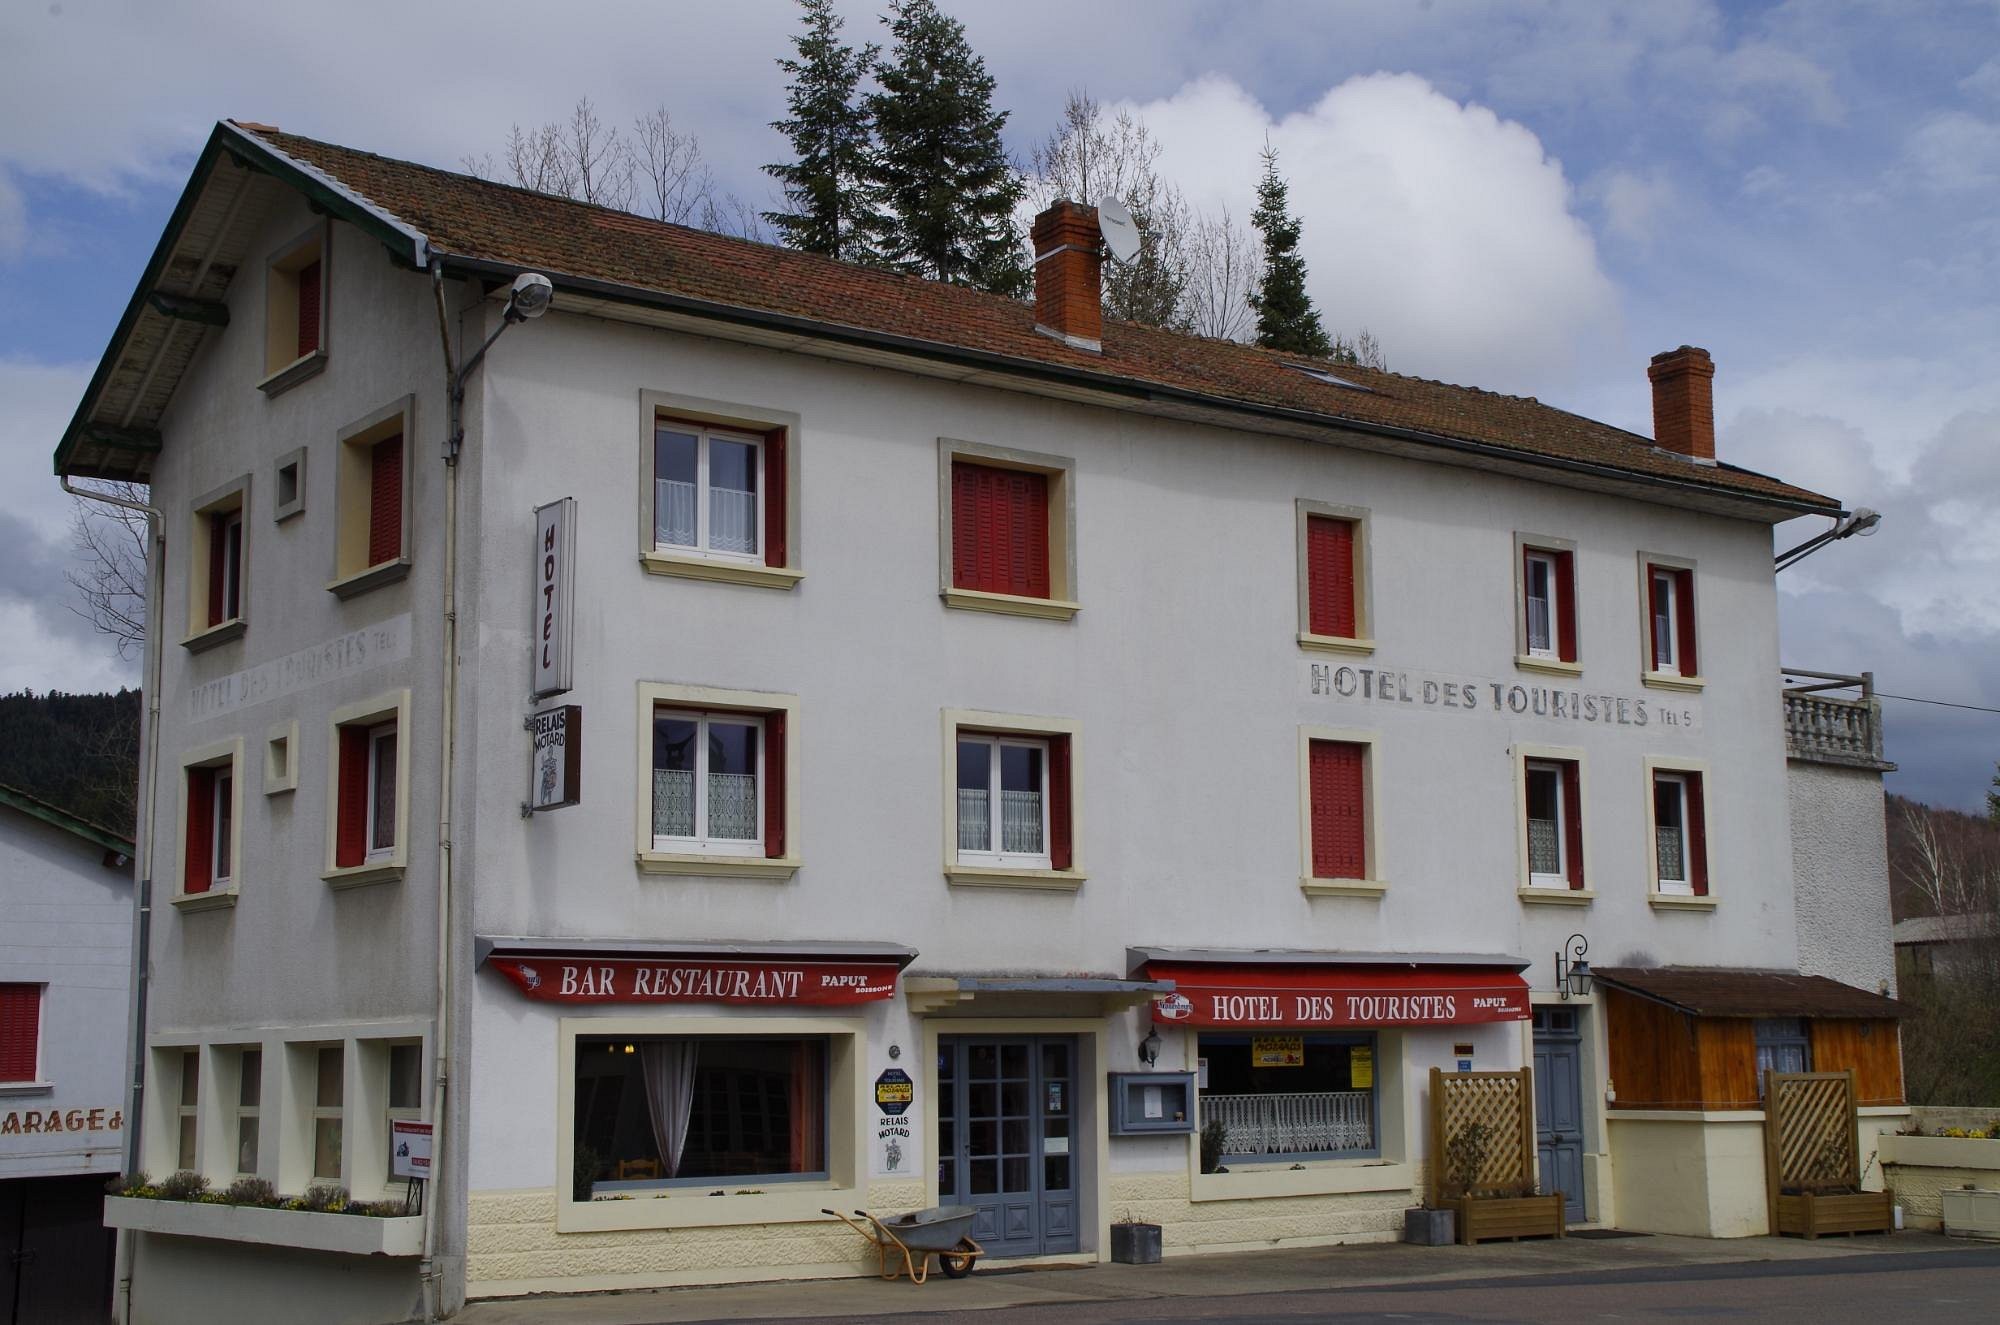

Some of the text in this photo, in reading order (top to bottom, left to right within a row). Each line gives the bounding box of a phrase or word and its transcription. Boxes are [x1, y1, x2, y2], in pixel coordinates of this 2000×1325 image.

[543, 523, 556, 670] HOTEL
[1311, 664, 1413, 703] HOTEL
[1423, 680, 1478, 709] DES
[1489, 683, 1649, 727] TOURISTES
[535, 711, 566, 736] RELAIS
[534, 731, 565, 754] MOTARD
[559, 966, 804, 999] BAR RESTAURANT
[821, 975, 868, 987] PAPUT
[1212, 995, 1457, 1022] HOTEL DES TOURISTES
[1473, 997, 1507, 1008] PAPUT
[0, 1108, 105, 1135] ARAGE
[878, 1127, 910, 1140] MOTARD
[880, 1116, 909, 1127] RELAIS
